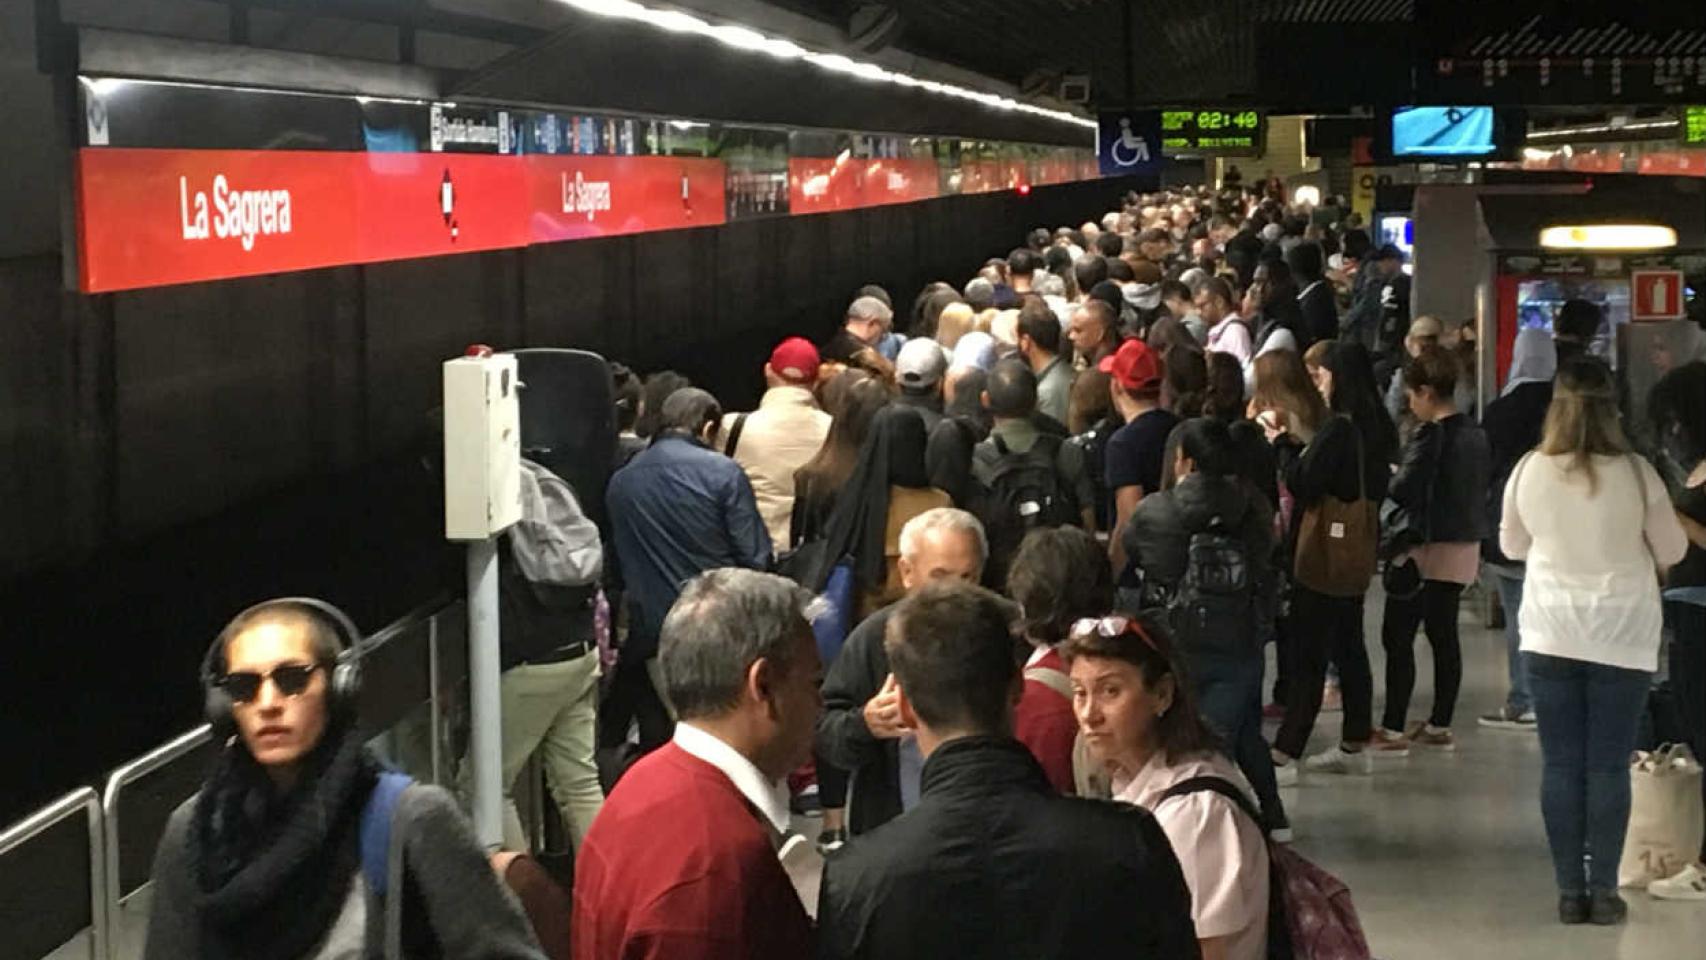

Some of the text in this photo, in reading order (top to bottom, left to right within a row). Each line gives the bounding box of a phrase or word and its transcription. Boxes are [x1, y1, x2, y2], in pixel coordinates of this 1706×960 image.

[1197, 111, 1258, 129] 02:40
[180, 174, 292, 252] La Sagrera
[562, 171, 611, 222] La Sagrera
